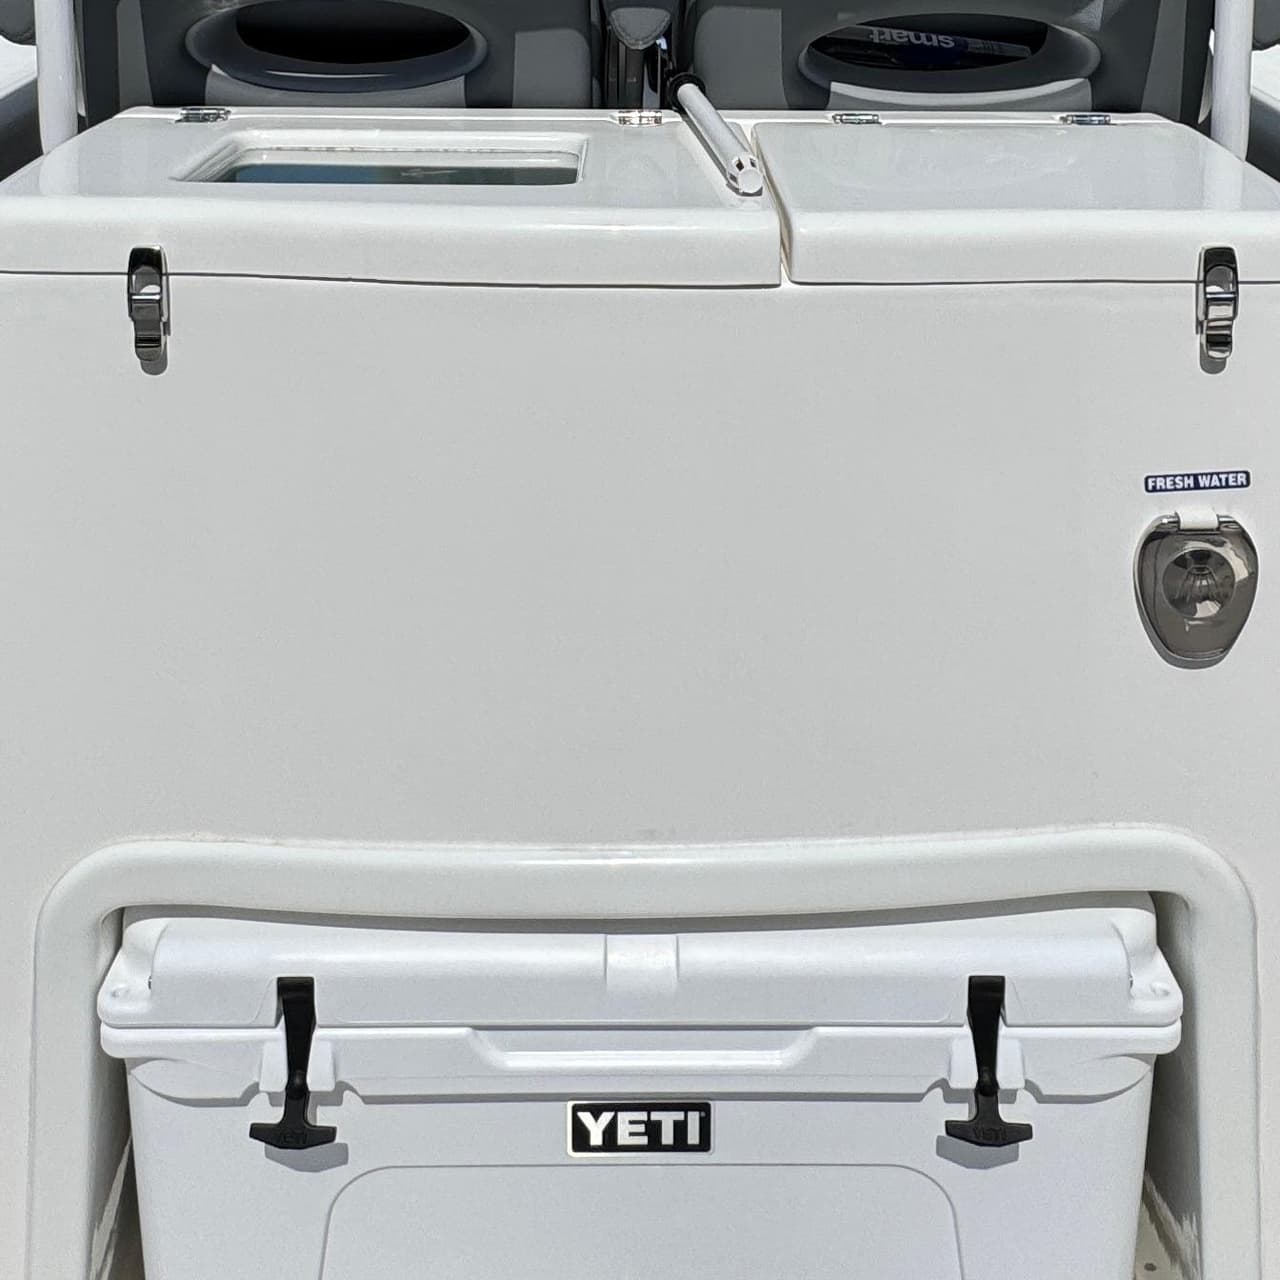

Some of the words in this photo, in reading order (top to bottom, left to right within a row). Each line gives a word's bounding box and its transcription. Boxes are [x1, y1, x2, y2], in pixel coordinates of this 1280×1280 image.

[869, 27, 955, 48] smart
[1147, 475, 1194, 491] FRESH
[1198, 472, 1247, 488] WATER
[576, 1110, 700, 1146] YETI
